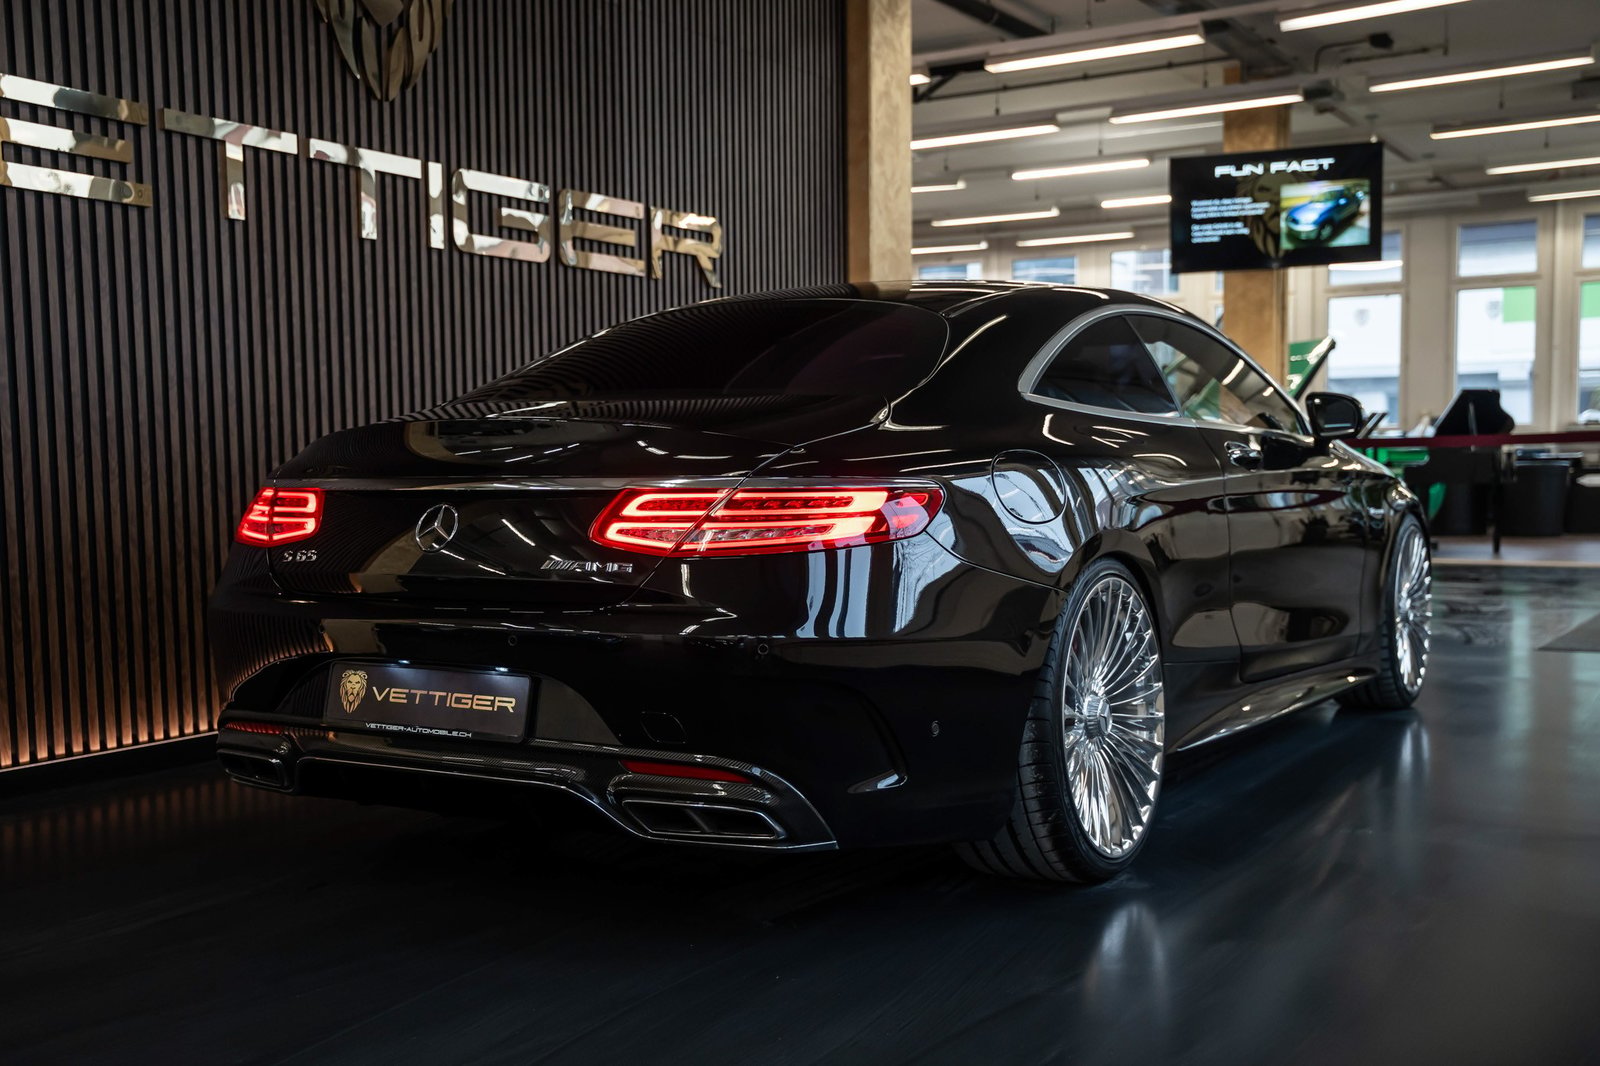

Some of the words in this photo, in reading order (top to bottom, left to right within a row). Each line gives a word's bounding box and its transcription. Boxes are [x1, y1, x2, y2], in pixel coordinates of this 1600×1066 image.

[1214, 163, 1264, 178] FUN
[1270, 157, 1335, 174] FACT
[282, 550, 293, 562] S
[296, 550, 317, 562] 65
[572, 561, 633, 574] AMG
[372, 686, 516, 713] VETTIGER
[365, 722, 472, 738] VETTIGER-AUTOMOBILE.CH
